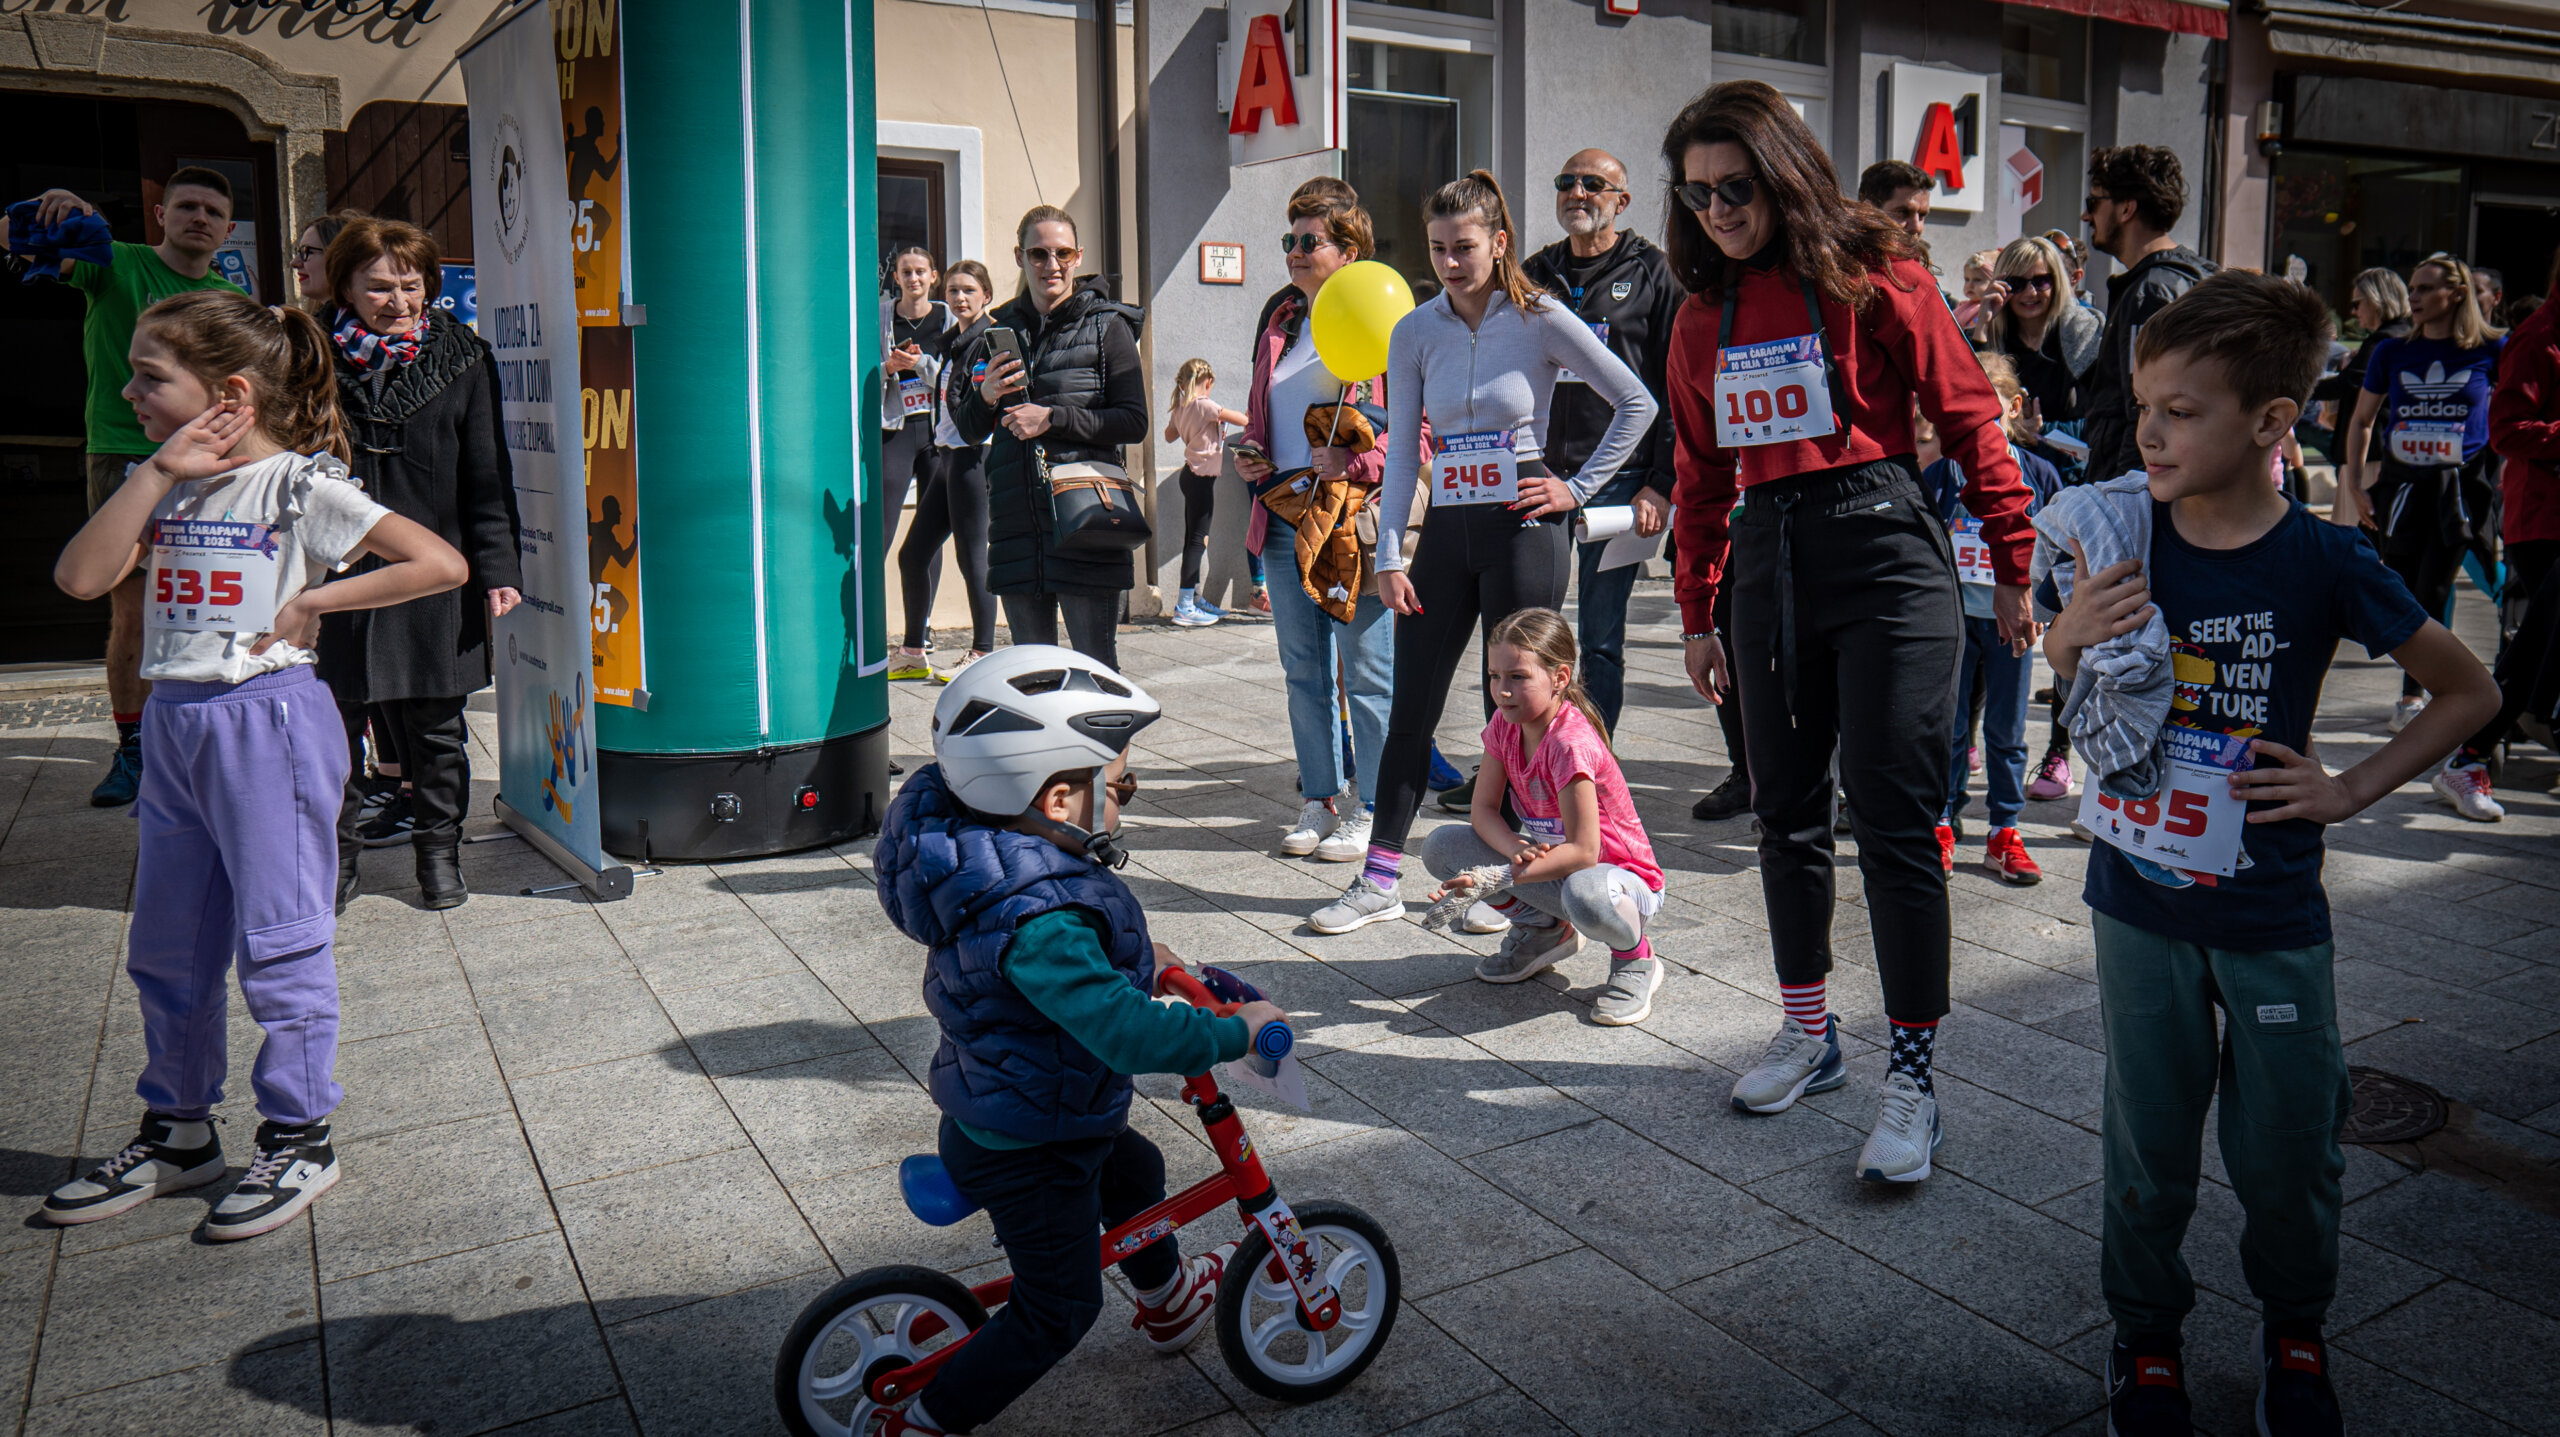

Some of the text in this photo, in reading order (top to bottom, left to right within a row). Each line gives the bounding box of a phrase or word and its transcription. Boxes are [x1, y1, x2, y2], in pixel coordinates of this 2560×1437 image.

[1914, 93, 1980, 188] A1
[1212, 247, 1234, 256] H 80
[494, 302, 542, 349] UDRUGA ZA
[1740, 359, 1761, 370] CILJA
[1763, 354, 1789, 367] 2025.
[1750, 342, 1798, 359] ČARAPAMA
[496, 359, 526, 402] NDROM
[1726, 384, 1809, 425] 100
[2398, 401, 2469, 417] adidas
[581, 387, 631, 450] ON
[1458, 443, 1473, 451] CILJA
[1475, 441, 1492, 449] 2025.
[1465, 433, 1499, 443] ČARAPAMA
[2402, 440, 2452, 456] 444
[1443, 463, 1502, 490] 246
[174, 534, 200, 546] CILJA
[203, 535, 235, 548] 2025.
[189, 522, 248, 537] ČARAPAMA
[1957, 546, 1994, 570] 55
[157, 568, 243, 606] 535
[589, 582, 619, 633] 5.
[2188, 611, 2275, 644] SEEK THE
[2241, 632, 2291, 660] AD-
[2221, 662, 2273, 691] VEN
[2208, 691, 2269, 725] TURE
[2161, 727, 2221, 752] ARAPAMA
[2166, 743, 2202, 763] 2025.
[2097, 789, 2210, 838] 85
[2280, 1012, 2295, 1020] OUT
